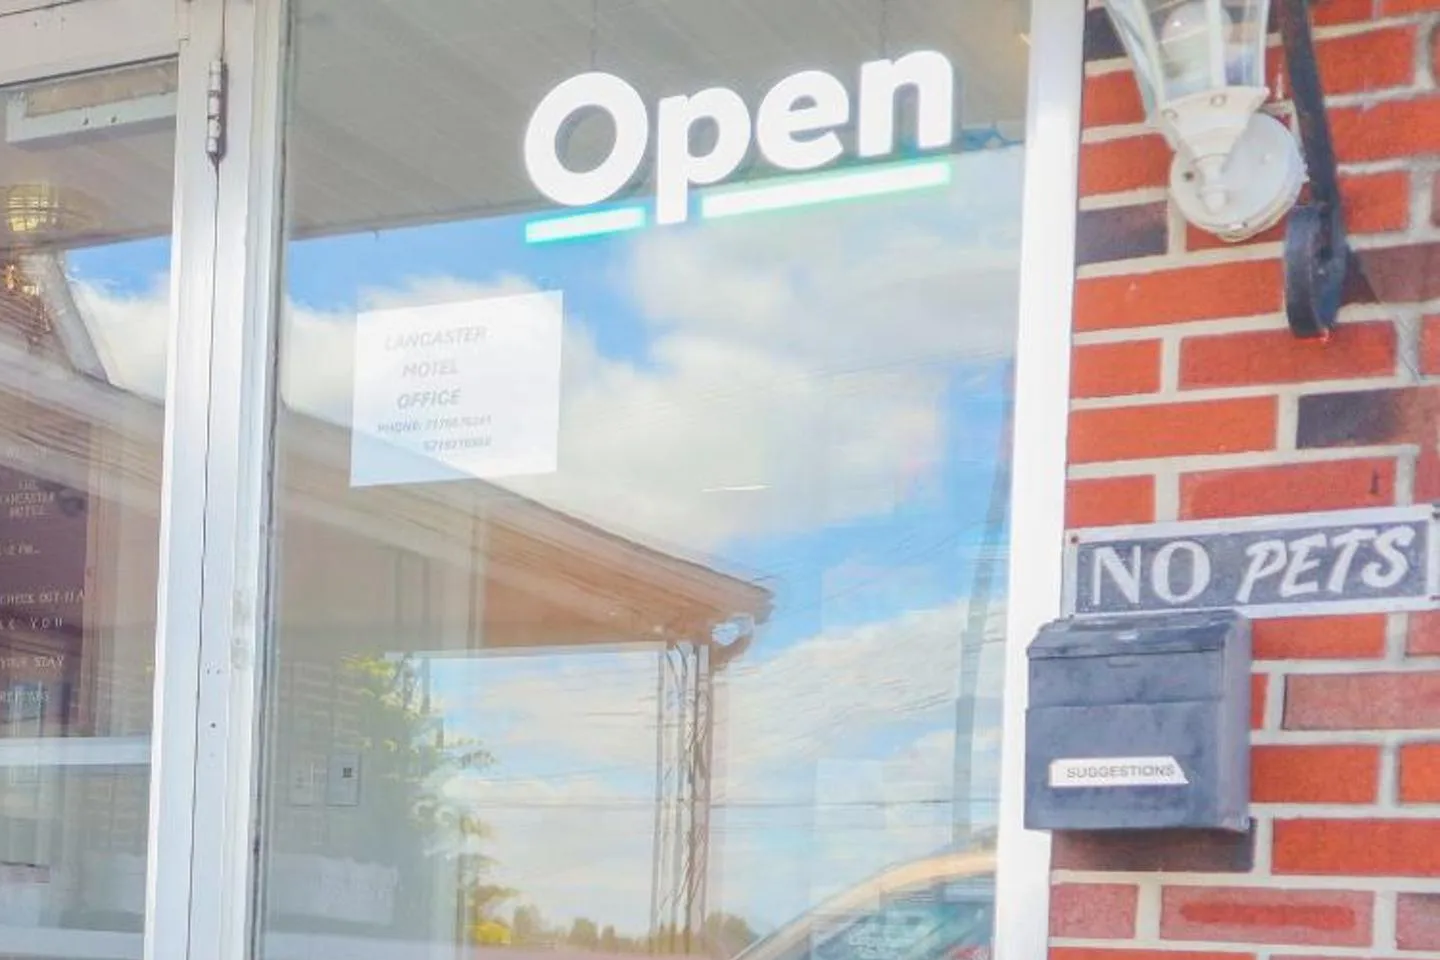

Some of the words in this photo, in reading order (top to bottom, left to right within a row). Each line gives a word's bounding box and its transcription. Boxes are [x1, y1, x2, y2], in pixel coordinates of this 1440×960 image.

[523, 49, 955, 225] Open
[385, 325, 488, 351] LANCASTER
[396, 388, 462, 410] OFFICE
[1092, 540, 1212, 606] NO
[1235, 526, 1417, 604] PETS
[1066, 764, 1176, 779] SUGGESTIONS
